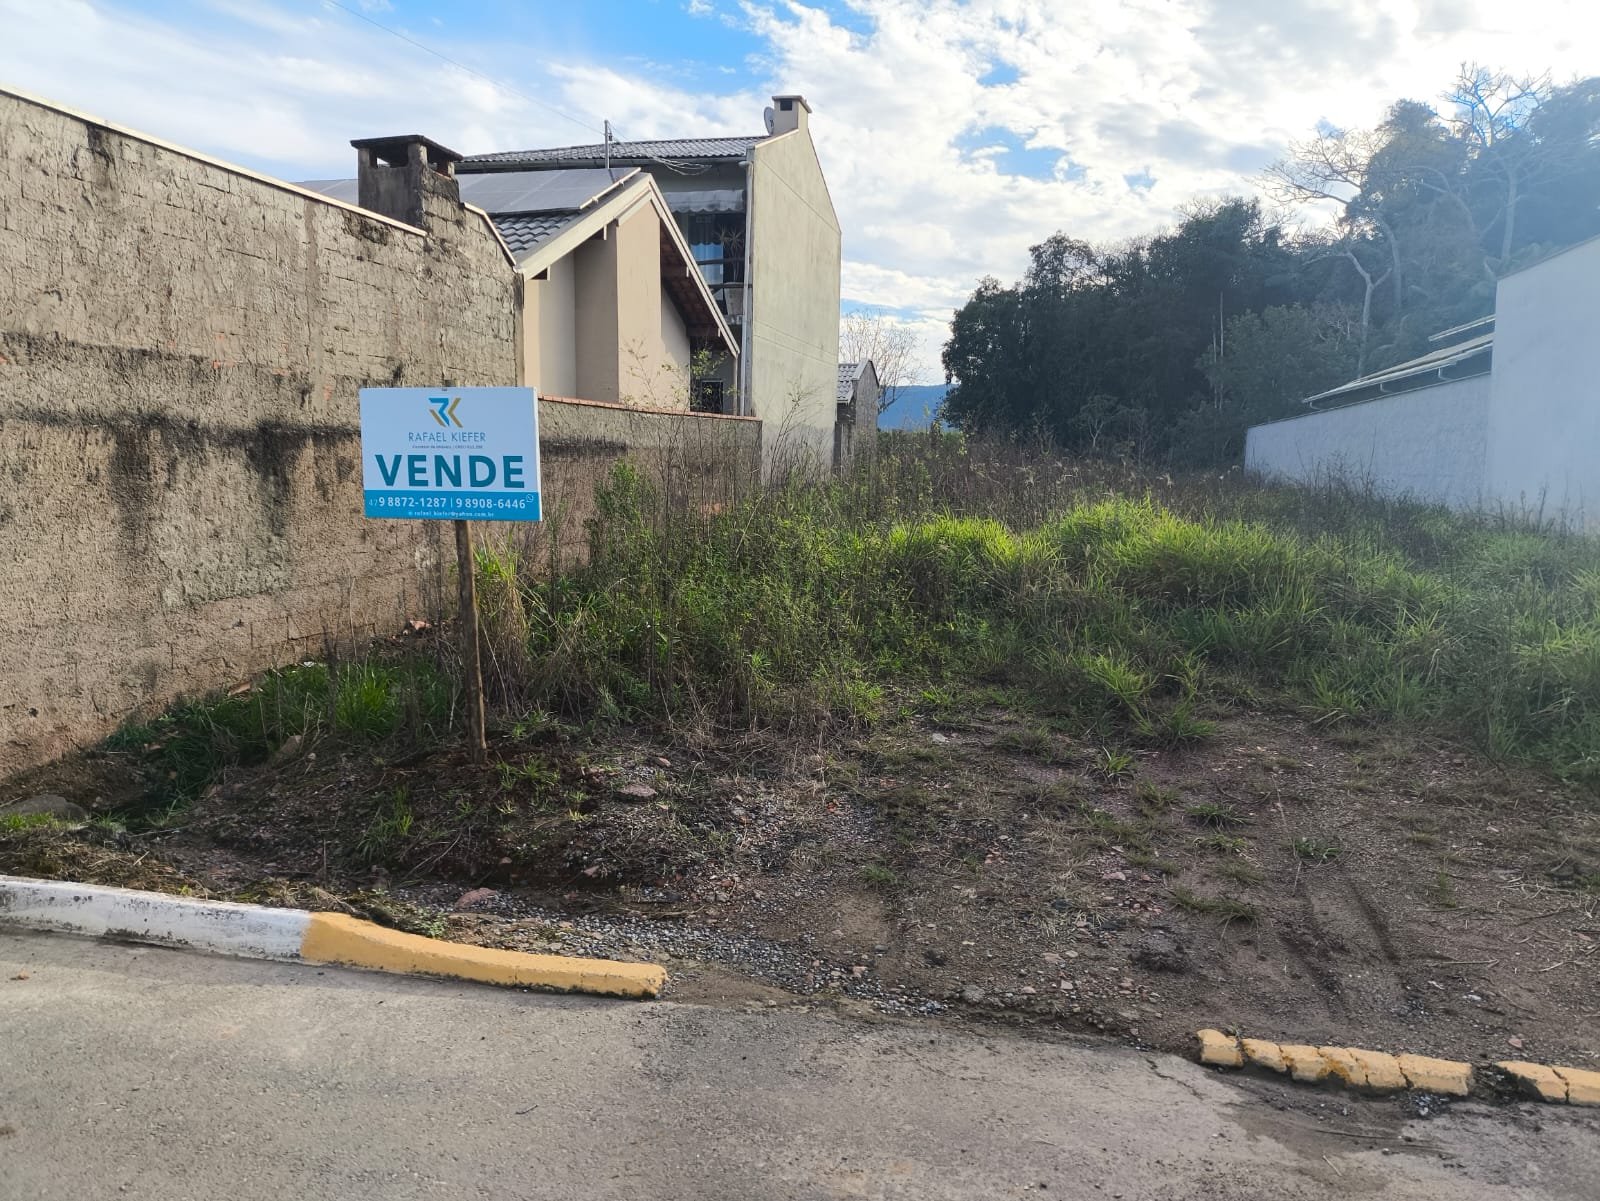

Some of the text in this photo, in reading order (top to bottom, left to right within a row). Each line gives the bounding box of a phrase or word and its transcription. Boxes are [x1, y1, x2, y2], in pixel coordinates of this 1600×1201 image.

[408, 432, 486, 442] RAFAEL KIEFER
[374, 454, 525, 489] VENDE
[387, 496, 447, 508] 8872-1287
[464, 498, 526, 509] 8908-6446
